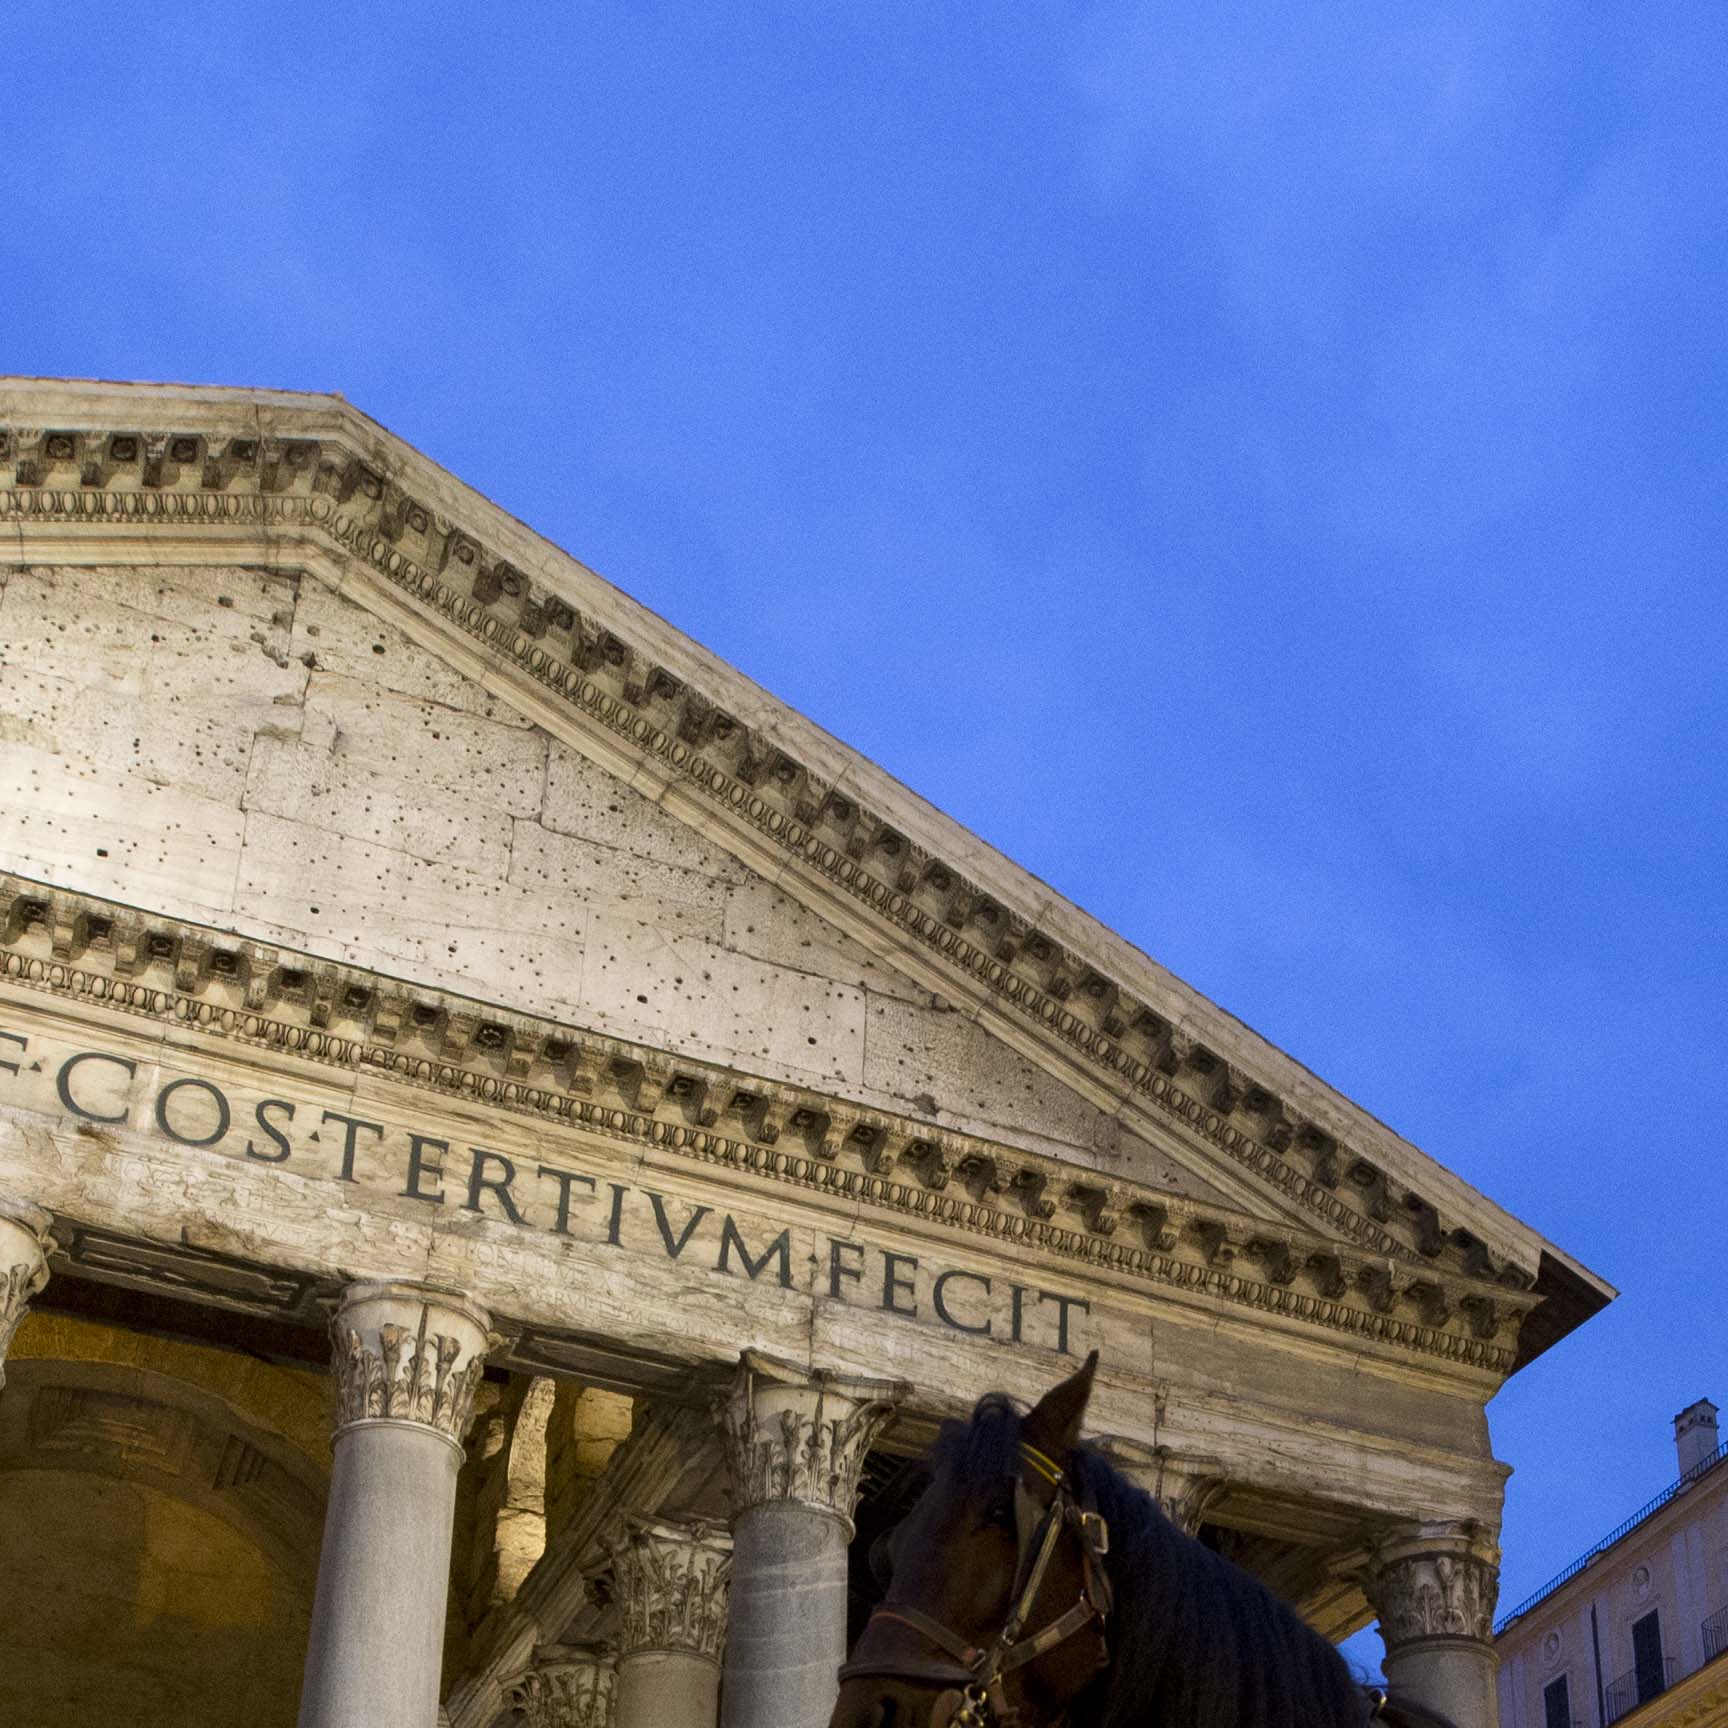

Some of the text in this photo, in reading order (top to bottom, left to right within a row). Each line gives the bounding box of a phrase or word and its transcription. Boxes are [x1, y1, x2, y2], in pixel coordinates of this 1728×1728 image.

[56, 1050, 296, 1163] COS
[318, 1110, 794, 1290] TERTIVM
[826, 1237, 1091, 1356] FECIT
